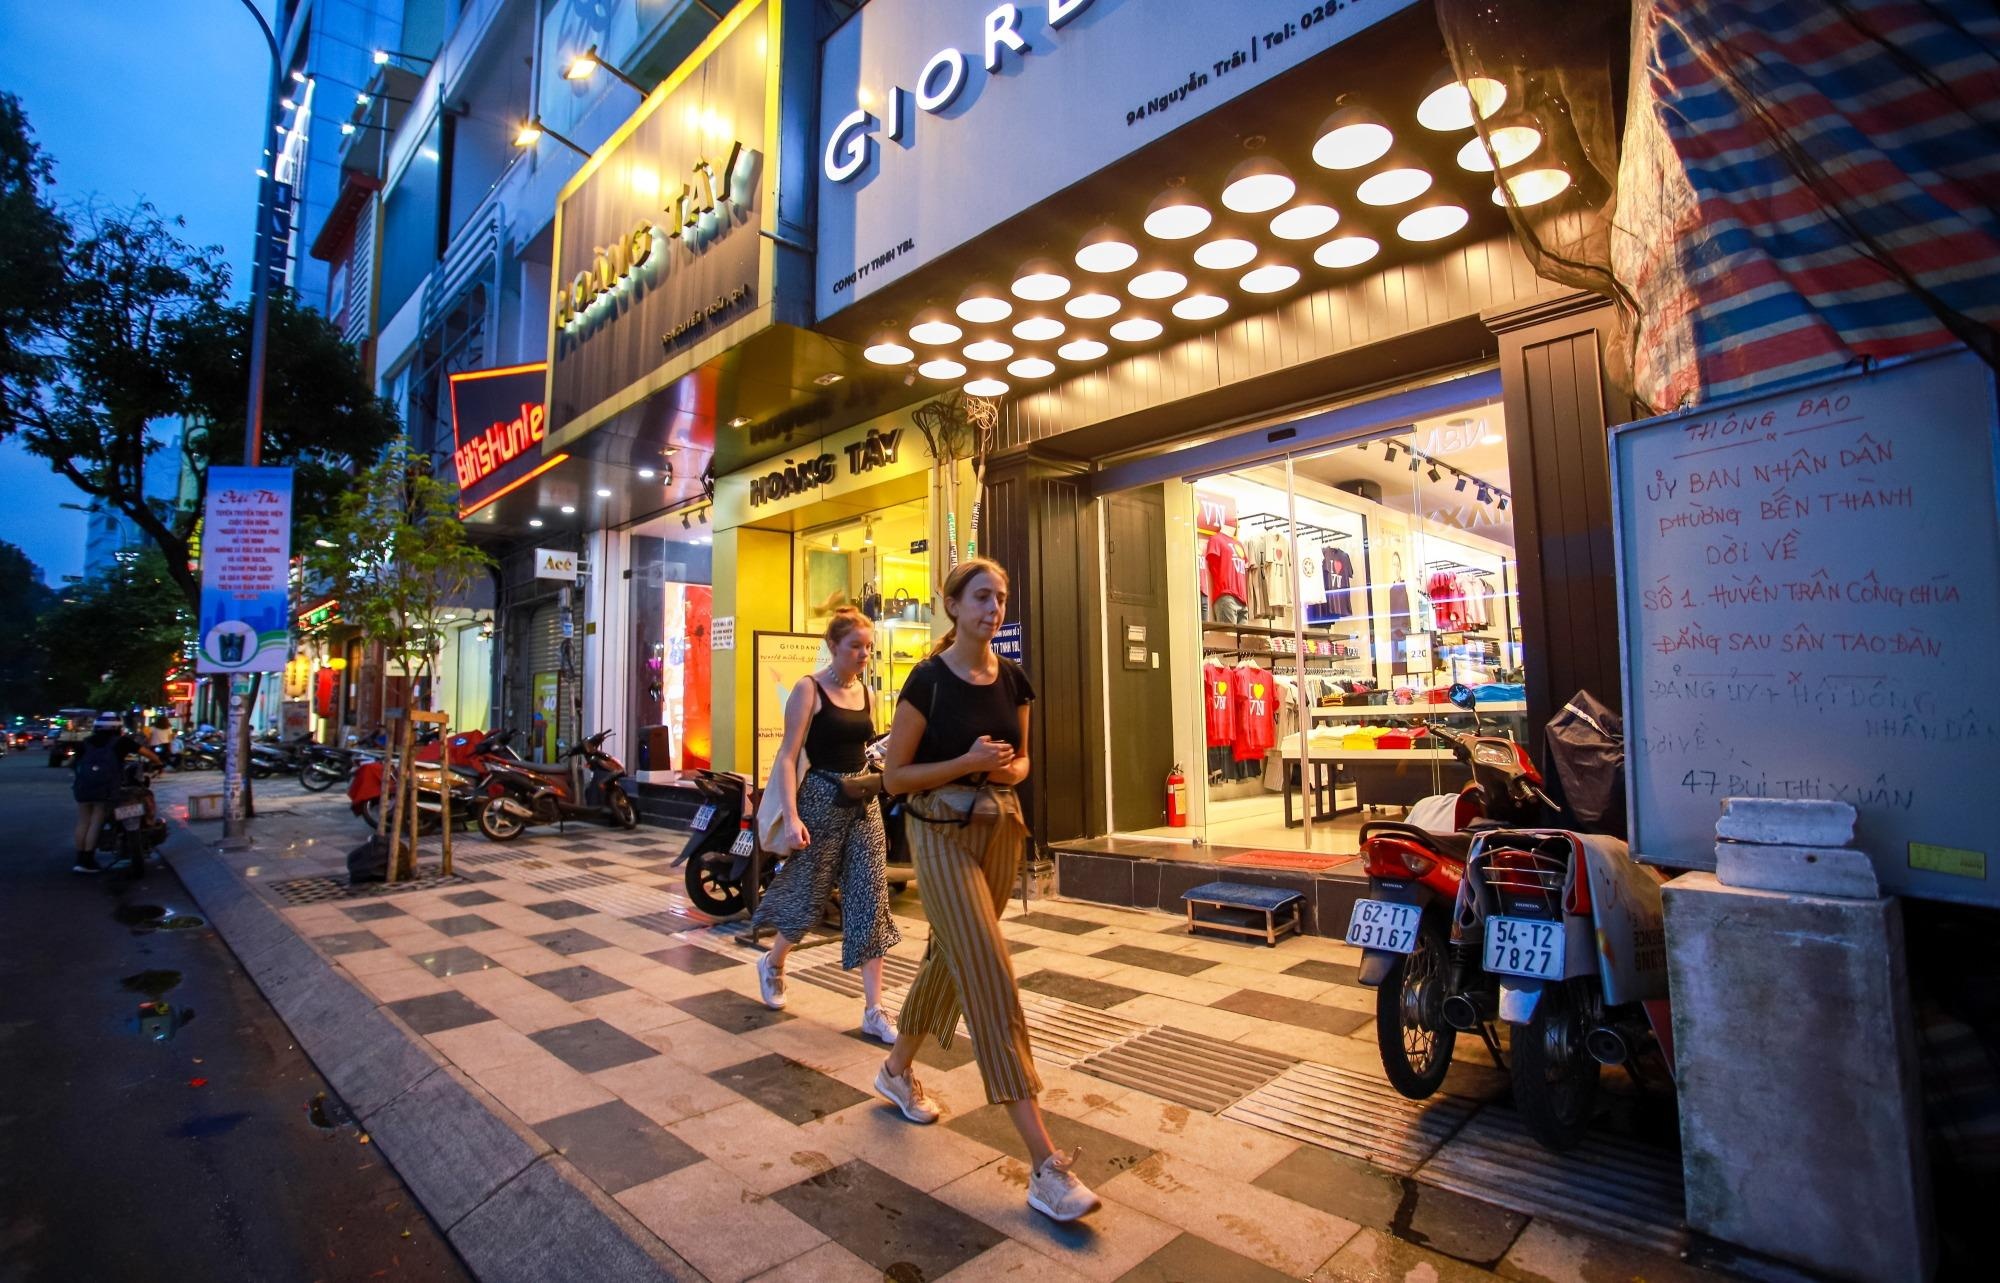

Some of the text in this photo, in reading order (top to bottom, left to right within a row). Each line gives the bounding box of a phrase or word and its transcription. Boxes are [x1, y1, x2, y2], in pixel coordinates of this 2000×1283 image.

[1126, 105, 1146, 126] 94
[1147, 71, 1209, 116] Nguyễn
[1262, 22, 1297, 50] Tel:
[857, 263, 871, 280] TY
[870, 248, 896, 272] TNHH
[896, 237, 916, 258] YBL
[1684, 411, 1776, 441] THÔNG
[749, 426, 905, 508] HOÀNG TÂY
[1689, 467, 1741, 493] BAN
[1753, 447, 1828, 484] NHÂN
[1839, 432, 1894, 468] DÂN
[1760, 485, 1810, 521] BẾN
[1819, 476, 1914, 509] THÀNH
[1762, 528, 1801, 561] VỀ
[1782, 568, 1840, 600] TRÂN
[1847, 569, 1903, 606] CÔNG
[1908, 574, 1961, 605] CHÚA
[780, 643, 821, 651] GIORDANO
[1728, 638, 1771, 651] SAU
[1782, 622, 1826, 651] SÂN
[1832, 633, 1886, 652] TAO
[1681, 768, 1721, 796] 47
[1350, 923, 1413, 951] 031.67
[1496, 920, 1553, 950] 54-T2
[1494, 944, 1552, 975] 7827
